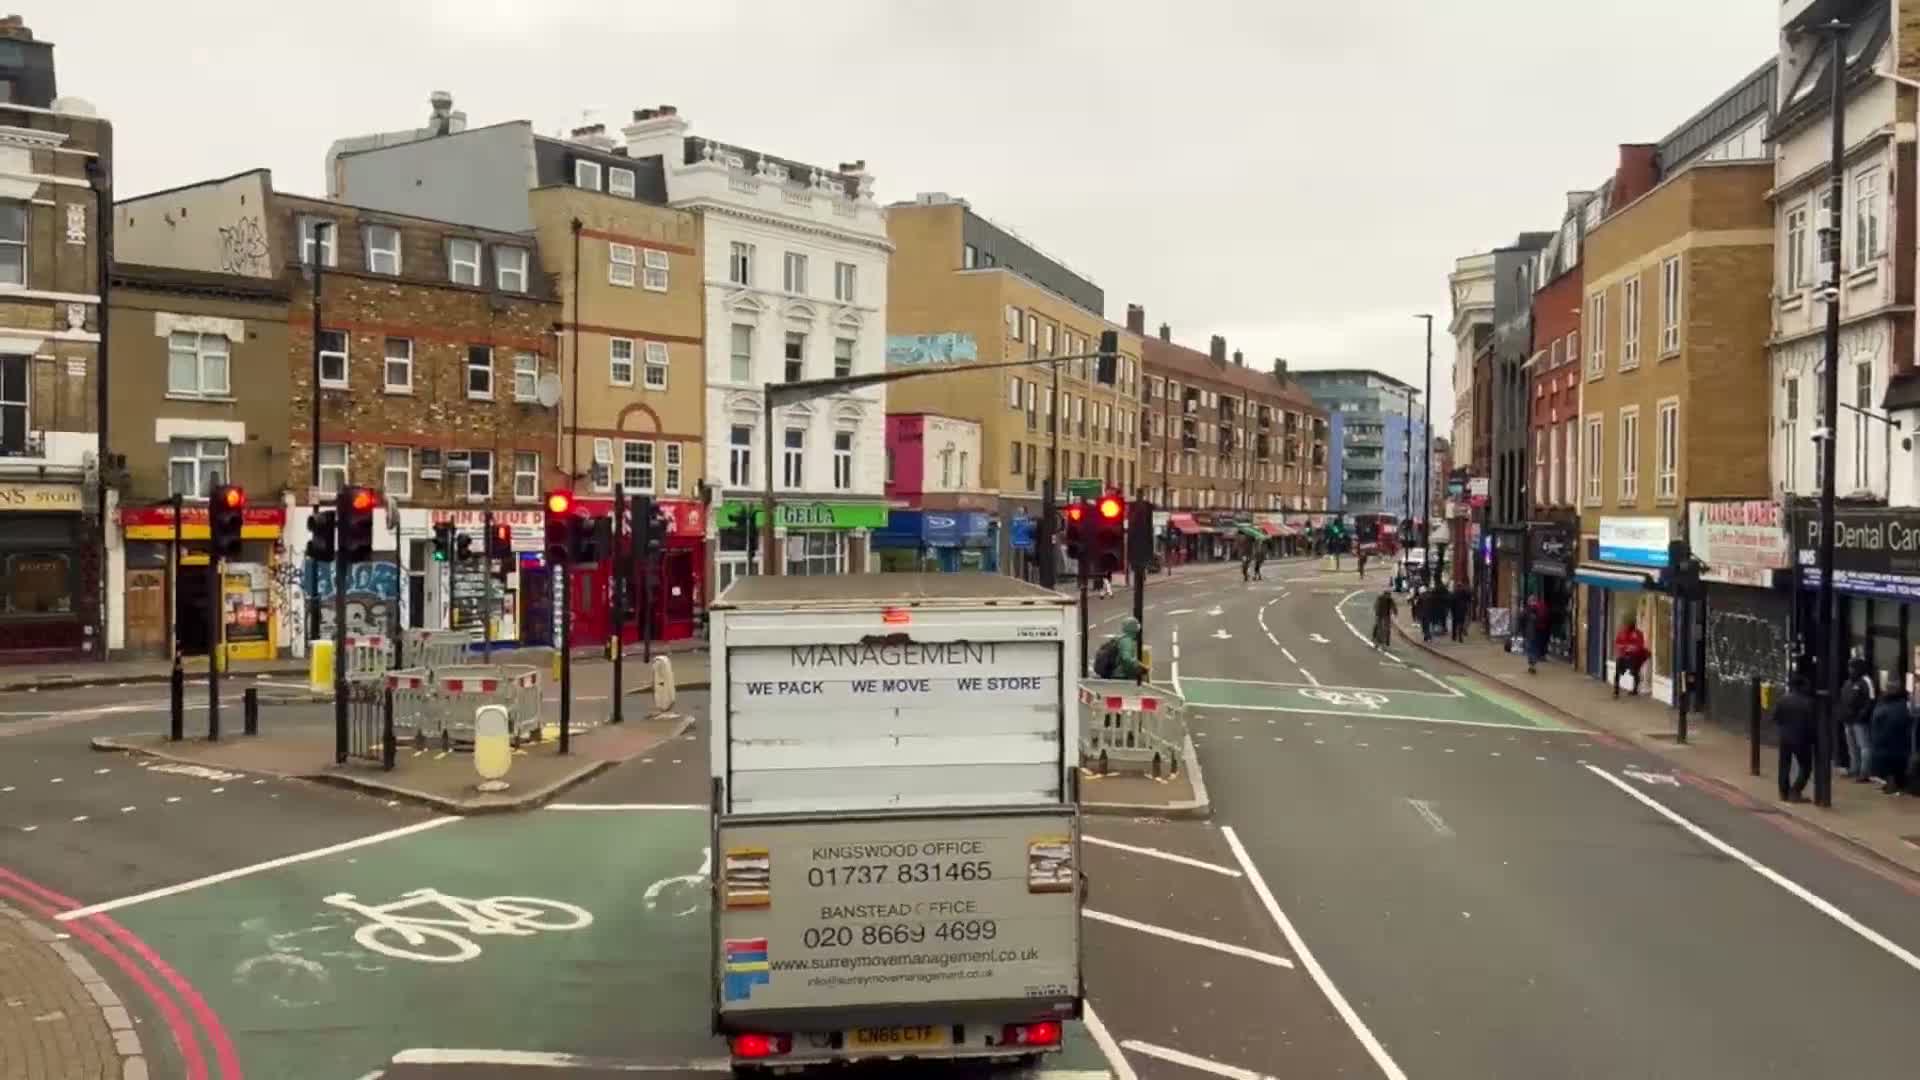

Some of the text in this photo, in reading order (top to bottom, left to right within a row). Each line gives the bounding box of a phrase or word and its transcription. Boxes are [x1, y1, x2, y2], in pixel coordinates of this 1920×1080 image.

[1834, 520, 1884, 549] Dental
[790, 641, 997, 667] MANAGEMENT
[746, 680, 824, 696] WE PACK
[852, 678, 930, 694] WE MOVE
[957, 675, 1041, 691] WE STORE
[812, 841, 984, 861] KINGSWOOD OFFICE
[807, 860, 992, 888] 01737 831465
[820, 902, 912, 920] BANSTEAD
[803, 920, 997, 949] 020 8669 4699
